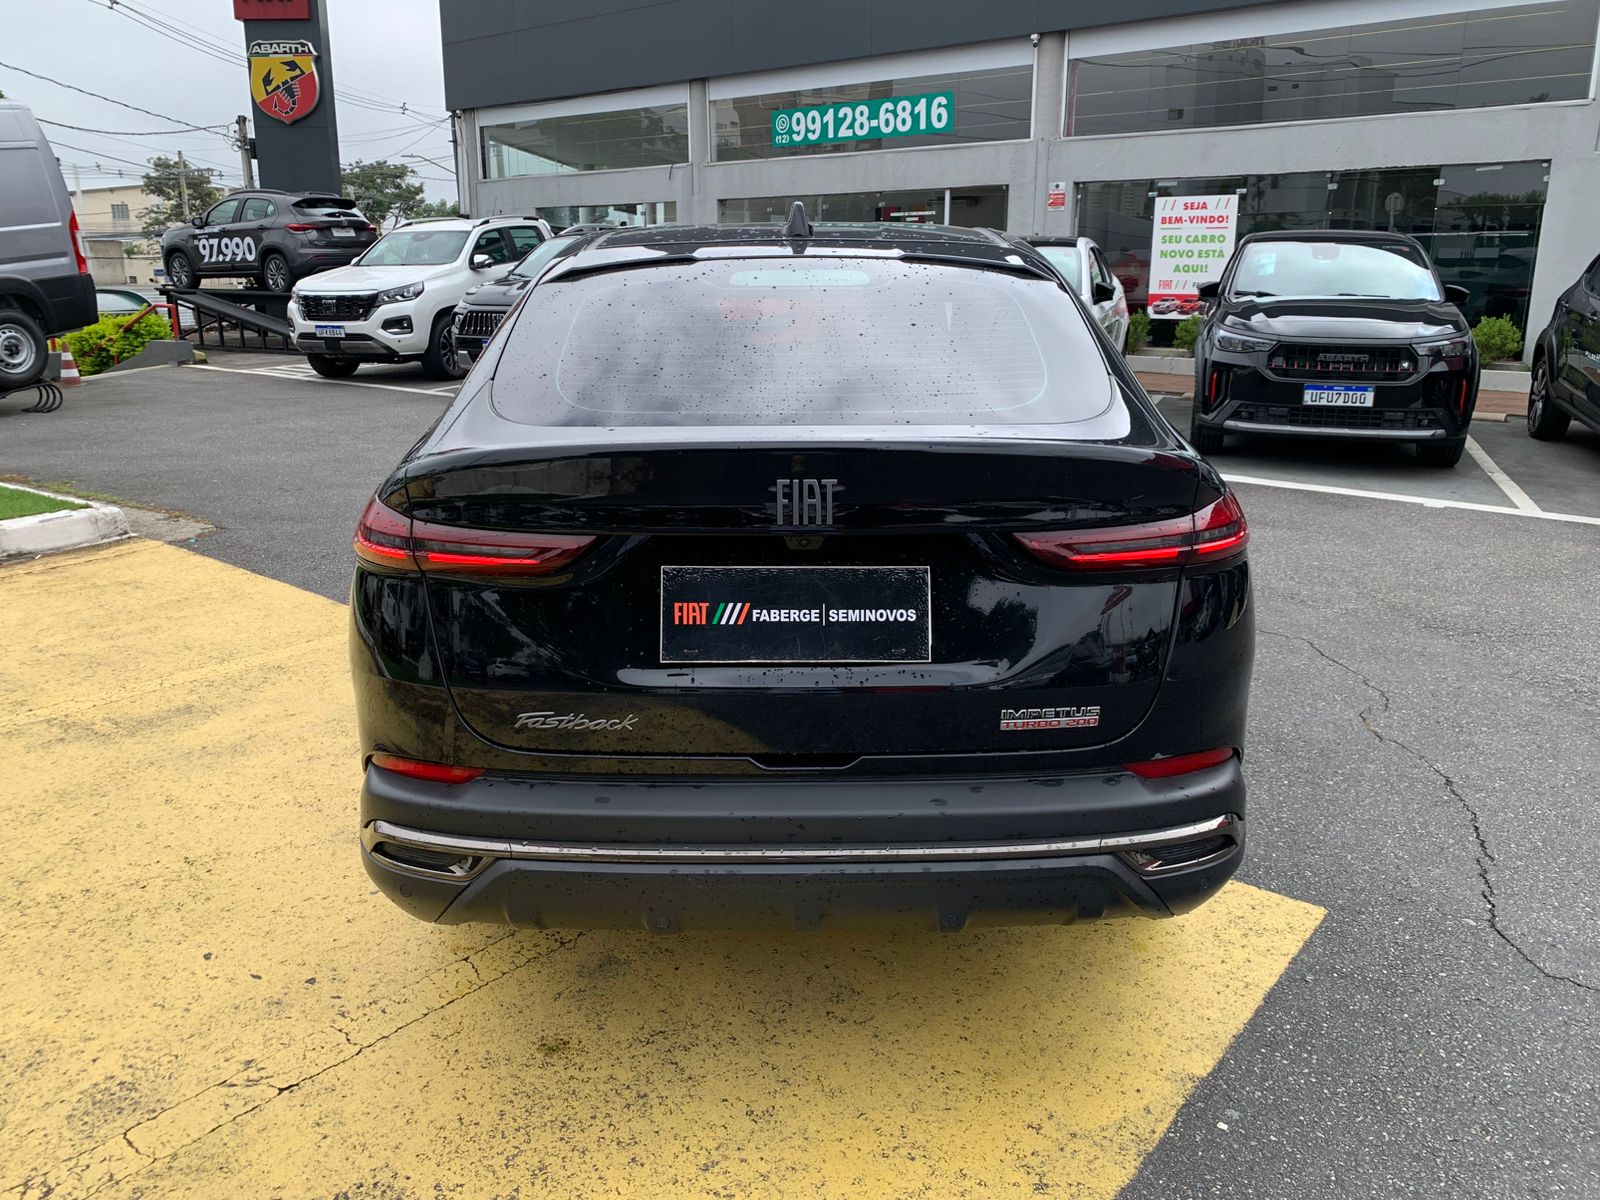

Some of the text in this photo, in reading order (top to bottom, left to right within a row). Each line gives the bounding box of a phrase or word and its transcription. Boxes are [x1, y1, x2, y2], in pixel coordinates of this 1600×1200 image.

[251, 43, 309, 54] ABARTH
[775, 96, 948, 144] (12) 99128-6816
[1183, 201, 1208, 211] SEJA
[1160, 215, 1229, 225] BEM-VINDO!
[1161, 234, 1226, 244] SEU CARRO
[198, 236, 256, 263] 97.990
[1160, 246, 1225, 259] NOVO ESTÁ
[1173, 264, 1208, 273] AQUI!
[1158, 279, 1174, 290] FIAT
[776, 478, 838, 526] FIAT
[673, 602, 917, 625] FIAT FABERGE SEMINOVOS
[1001, 706, 1101, 720] IMPETUS
[514, 711, 639, 731] Fastback
[1002, 718, 1098, 729] TURBO 200
